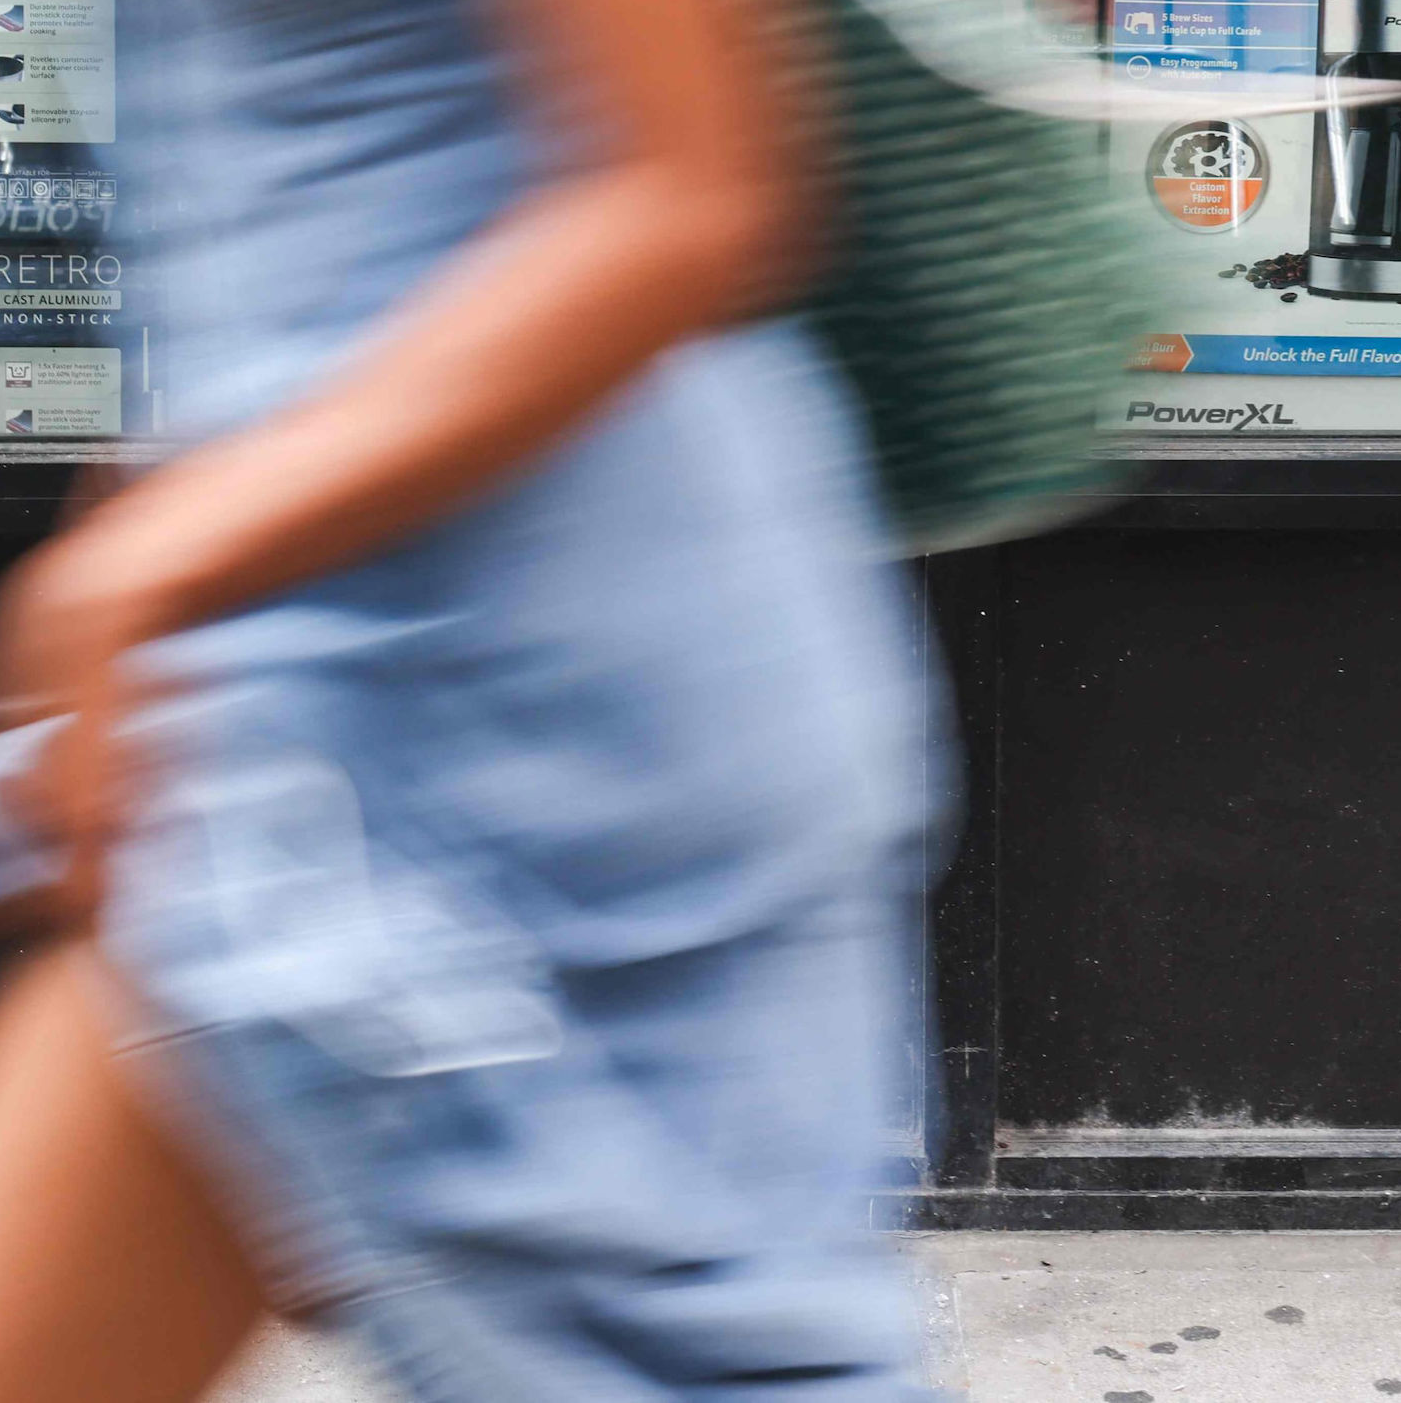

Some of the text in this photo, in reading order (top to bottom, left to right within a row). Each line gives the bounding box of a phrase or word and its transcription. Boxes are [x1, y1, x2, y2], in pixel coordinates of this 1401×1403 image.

[1189, 182, 1225, 192] Custom
[1193, 194, 1222, 204] Flavor
[1182, 205, 1230, 216] Extraction
[4, 295, 112, 305] CAST ALUMINUM
[3, 314, 111, 324] NON-STICK
[1243, 348, 1298, 362] Unlock
[1301, 349, 1326, 363] the
[1329, 349, 1358, 363] Full
[1126, 401, 1294, 431] PowerXL
